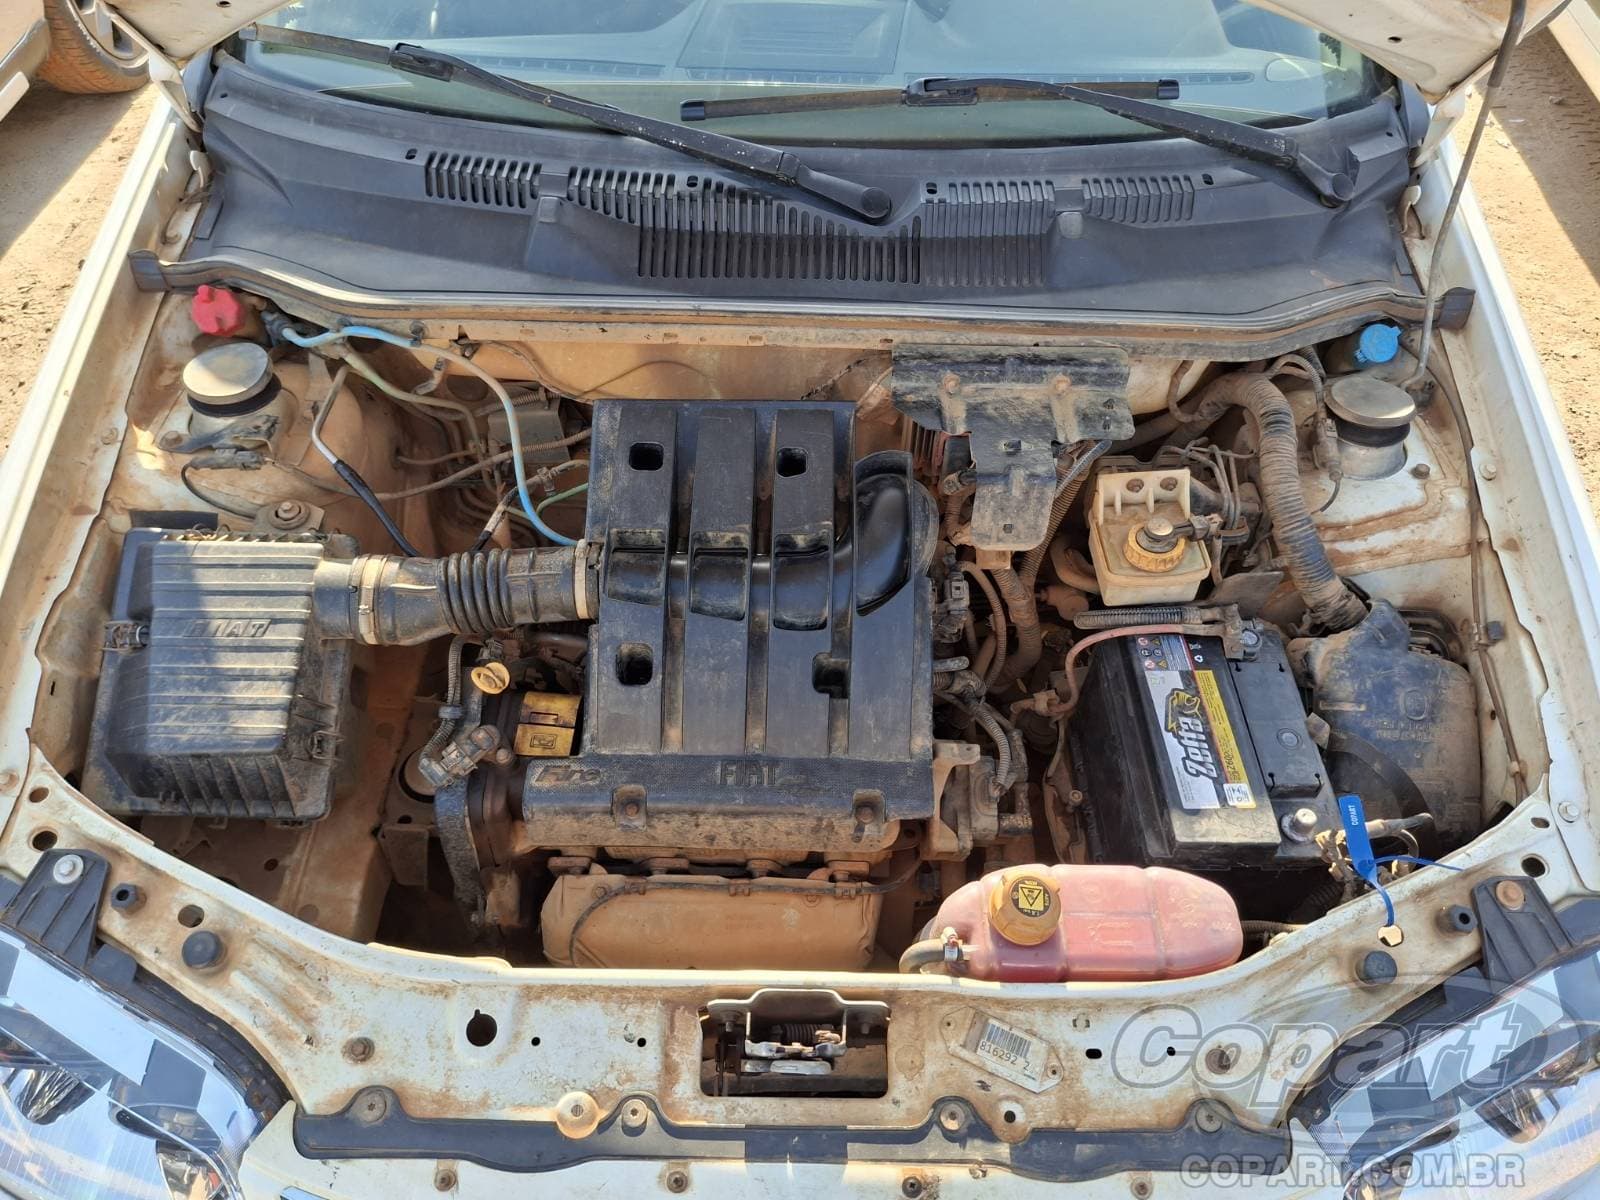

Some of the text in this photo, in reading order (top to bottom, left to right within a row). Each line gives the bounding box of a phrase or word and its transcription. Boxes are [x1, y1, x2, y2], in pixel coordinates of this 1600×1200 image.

[183, 618, 272, 638] FIAT
[1178, 715, 1219, 779] Zetta
[1348, 804, 1359, 826] COPART
[979, 1040, 1018, 1066] 816292
